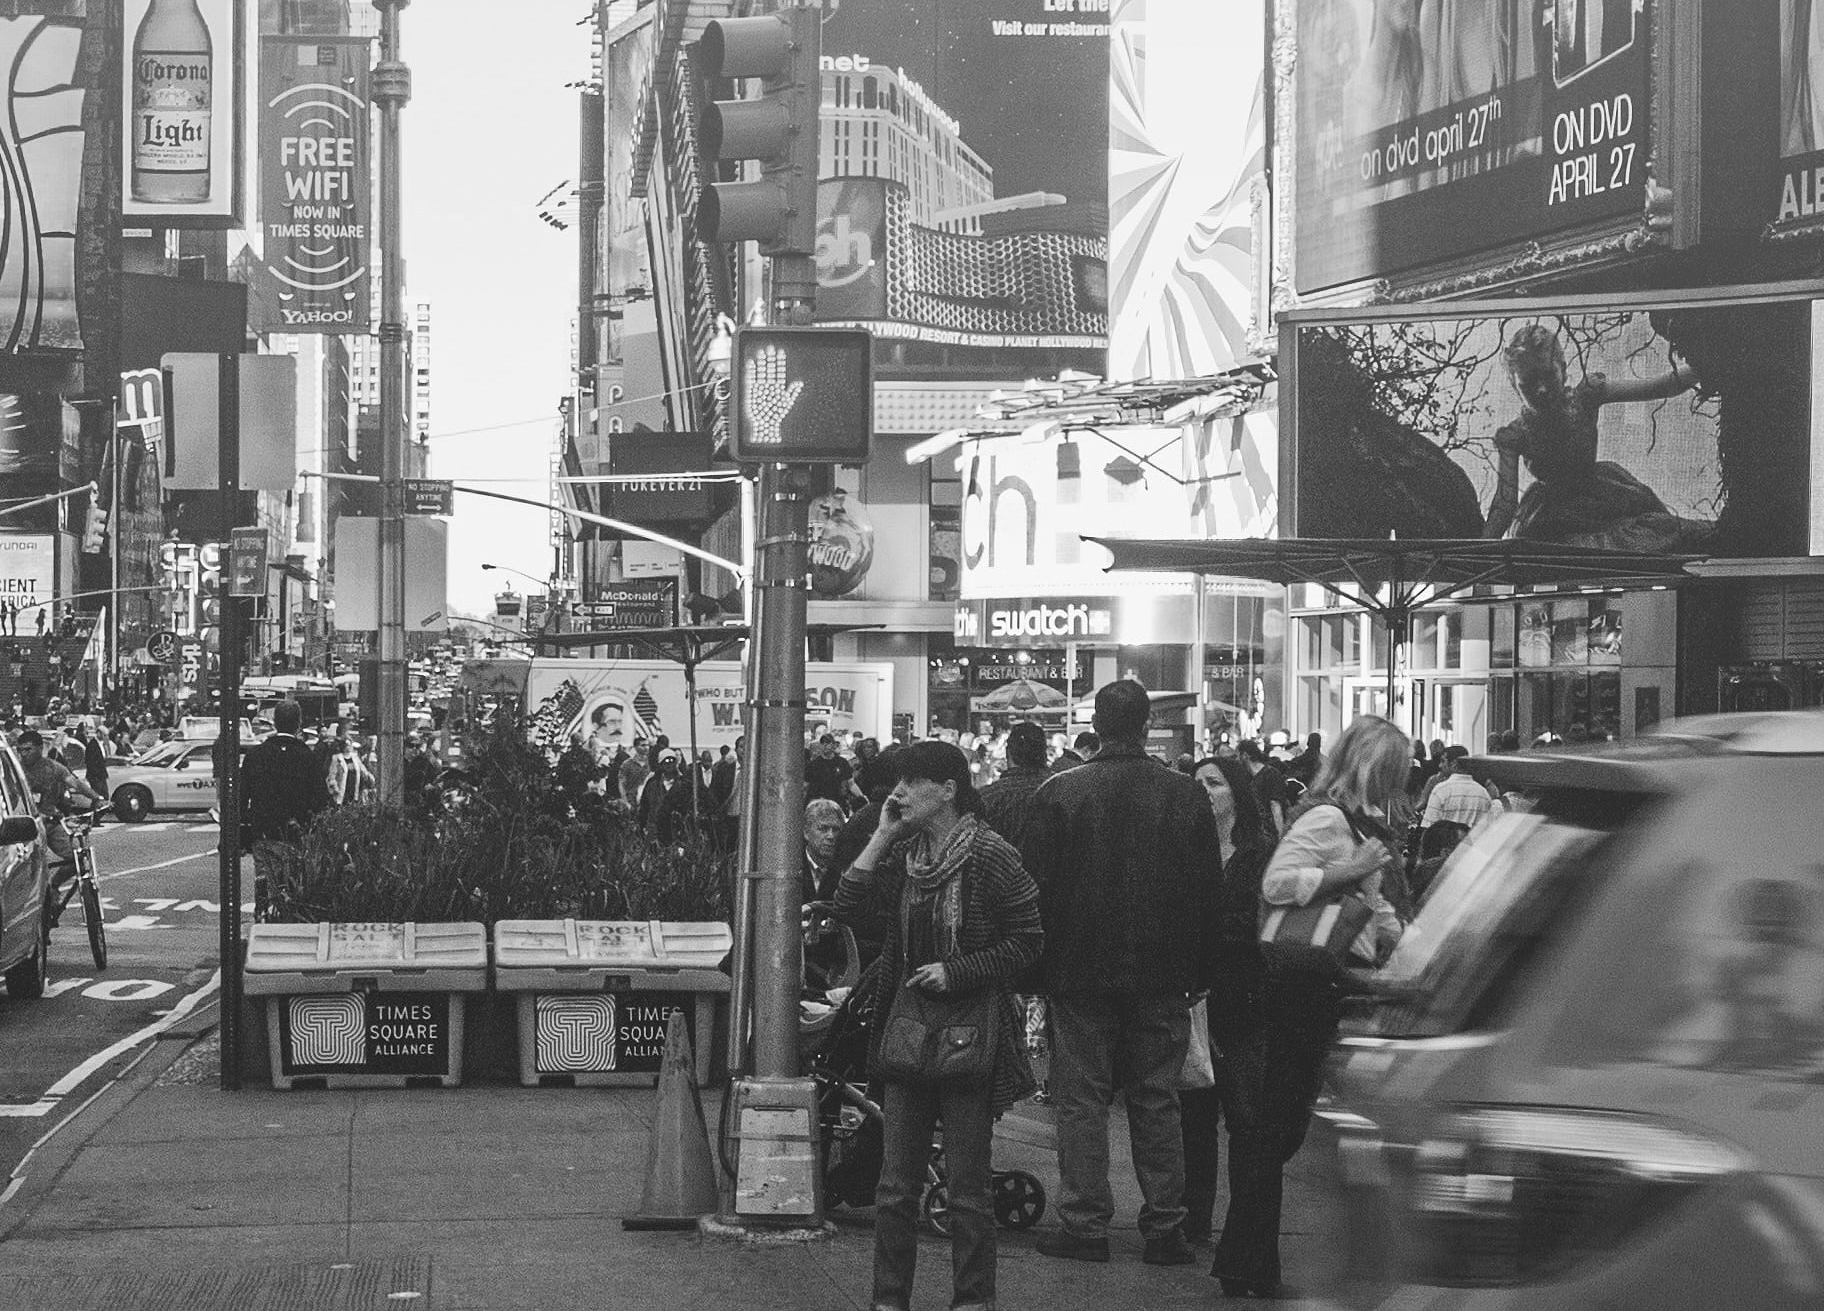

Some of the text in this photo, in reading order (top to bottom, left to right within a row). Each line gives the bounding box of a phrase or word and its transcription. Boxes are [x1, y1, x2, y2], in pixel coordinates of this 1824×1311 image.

[992, 19, 1048, 36] Visit our
[818, 53, 870, 73] net
[138, 59, 208, 87] Corona
[142, 115, 202, 147] Light
[1552, 93, 1634, 156] ON DVD
[280, 137, 355, 167] FREE
[1360, 147, 1382, 180] on
[1385, 126, 1419, 172] dvd
[1425, 113, 1463, 166] april
[1548, 143, 1636, 206] APRIL 27
[284, 171, 349, 201] WIFI
[293, 205, 341, 219] NOW IN
[269, 224, 365, 241] TIMES SQUARE
[280, 308, 354, 325] YAHOO!
[919, 327, 961, 345] RESORT
[961, 332, 969, 345] &
[971, 332, 1004, 347] CASINO
[1005, 336, 1039, 348] PLANET
[408, 483, 418, 491] NO
[622, 478, 685, 492] FOREVER
[991, 604, 1088, 637] swatch
[978, 665, 1058, 680] RESTAURANT &
[723, 687, 744, 698] BUT
[375, 1005, 432, 1021] TIMES
[369, 1024, 438, 1041] SQUARE
[619, 1025, 666, 1042] SQUA
[374, 1043, 434, 1056] ALLIANCE
